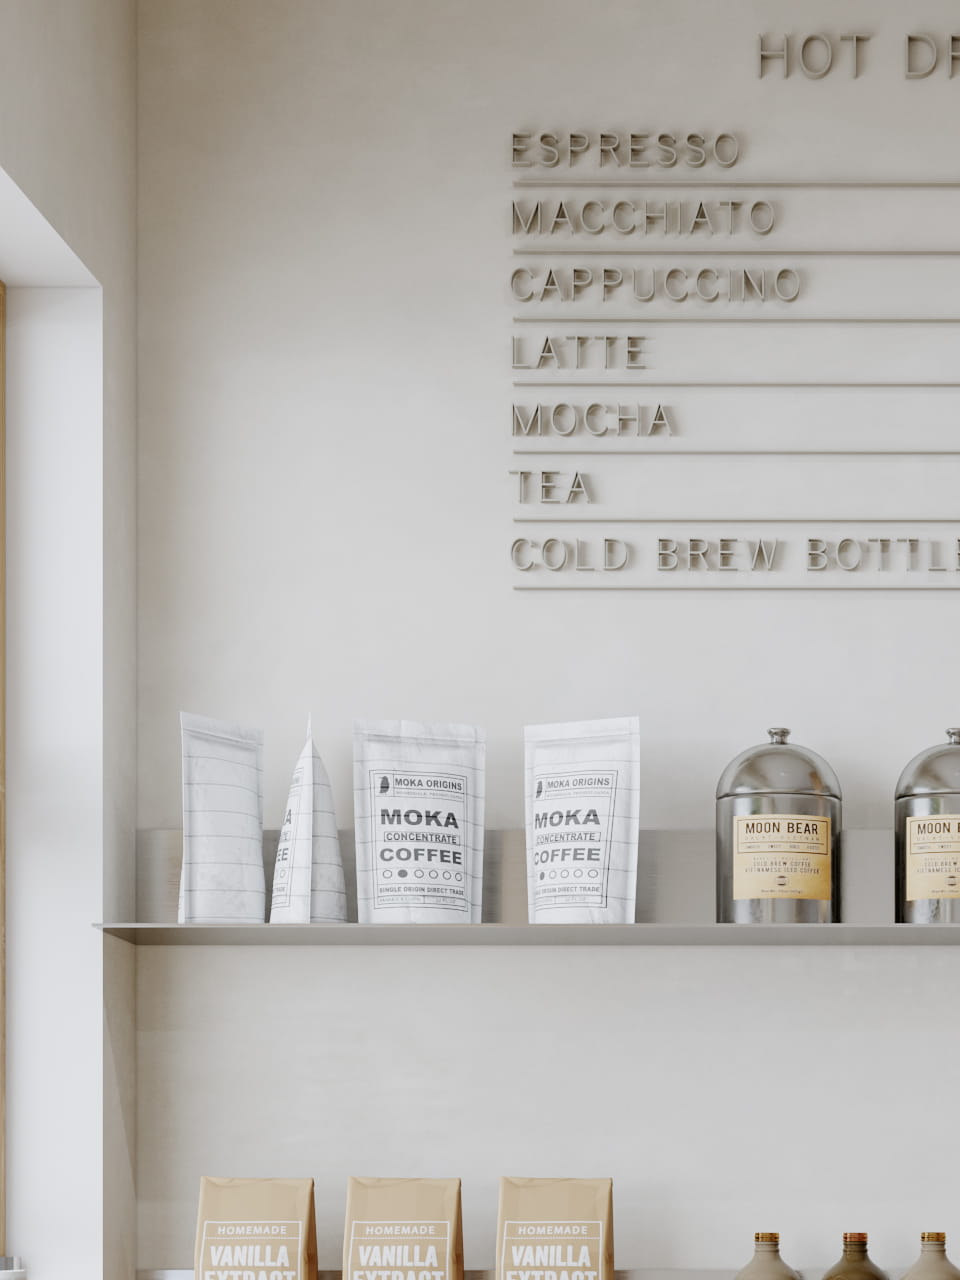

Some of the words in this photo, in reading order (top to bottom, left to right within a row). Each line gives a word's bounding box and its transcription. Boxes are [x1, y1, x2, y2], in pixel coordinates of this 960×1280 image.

[757, 34, 871, 80] HOT
[511, 132, 743, 169] ESPRESSO
[511, 200, 777, 236] MACCHIATO
[510, 268, 802, 304] CAPPUCCINO
[511, 336, 648, 371] LATTE
[511, 403, 676, 438] MOCHA
[510, 470, 595, 506] TEA
[510, 538, 630, 574] COLD
[657, 538, 778, 574] BREW
[394, 778, 423, 788] MOKA
[426, 779, 462, 790] ORIGINS
[547, 779, 570, 789] MOKA
[572, 778, 610, 787] ORIGINS
[380, 809, 459, 829] MOKA
[535, 809, 600, 829] MOKA
[745, 822, 780, 835] MOON
[787, 822, 818, 835] BEAR
[917, 822, 951, 835] MOON
[386, 832, 457, 844] CONCENTRATE
[380, 848, 462, 865] COFFEE
[218, 1225, 287, 1235] HOMEMADE
[366, 1225, 435, 1235] HOMEMADE
[518, 1225, 588, 1235] HOMEMADE
[210, 1245, 289, 1267] VANILLA
[358, 1245, 438, 1267] VANILLA
[511, 1245, 591, 1267] VANILLA
